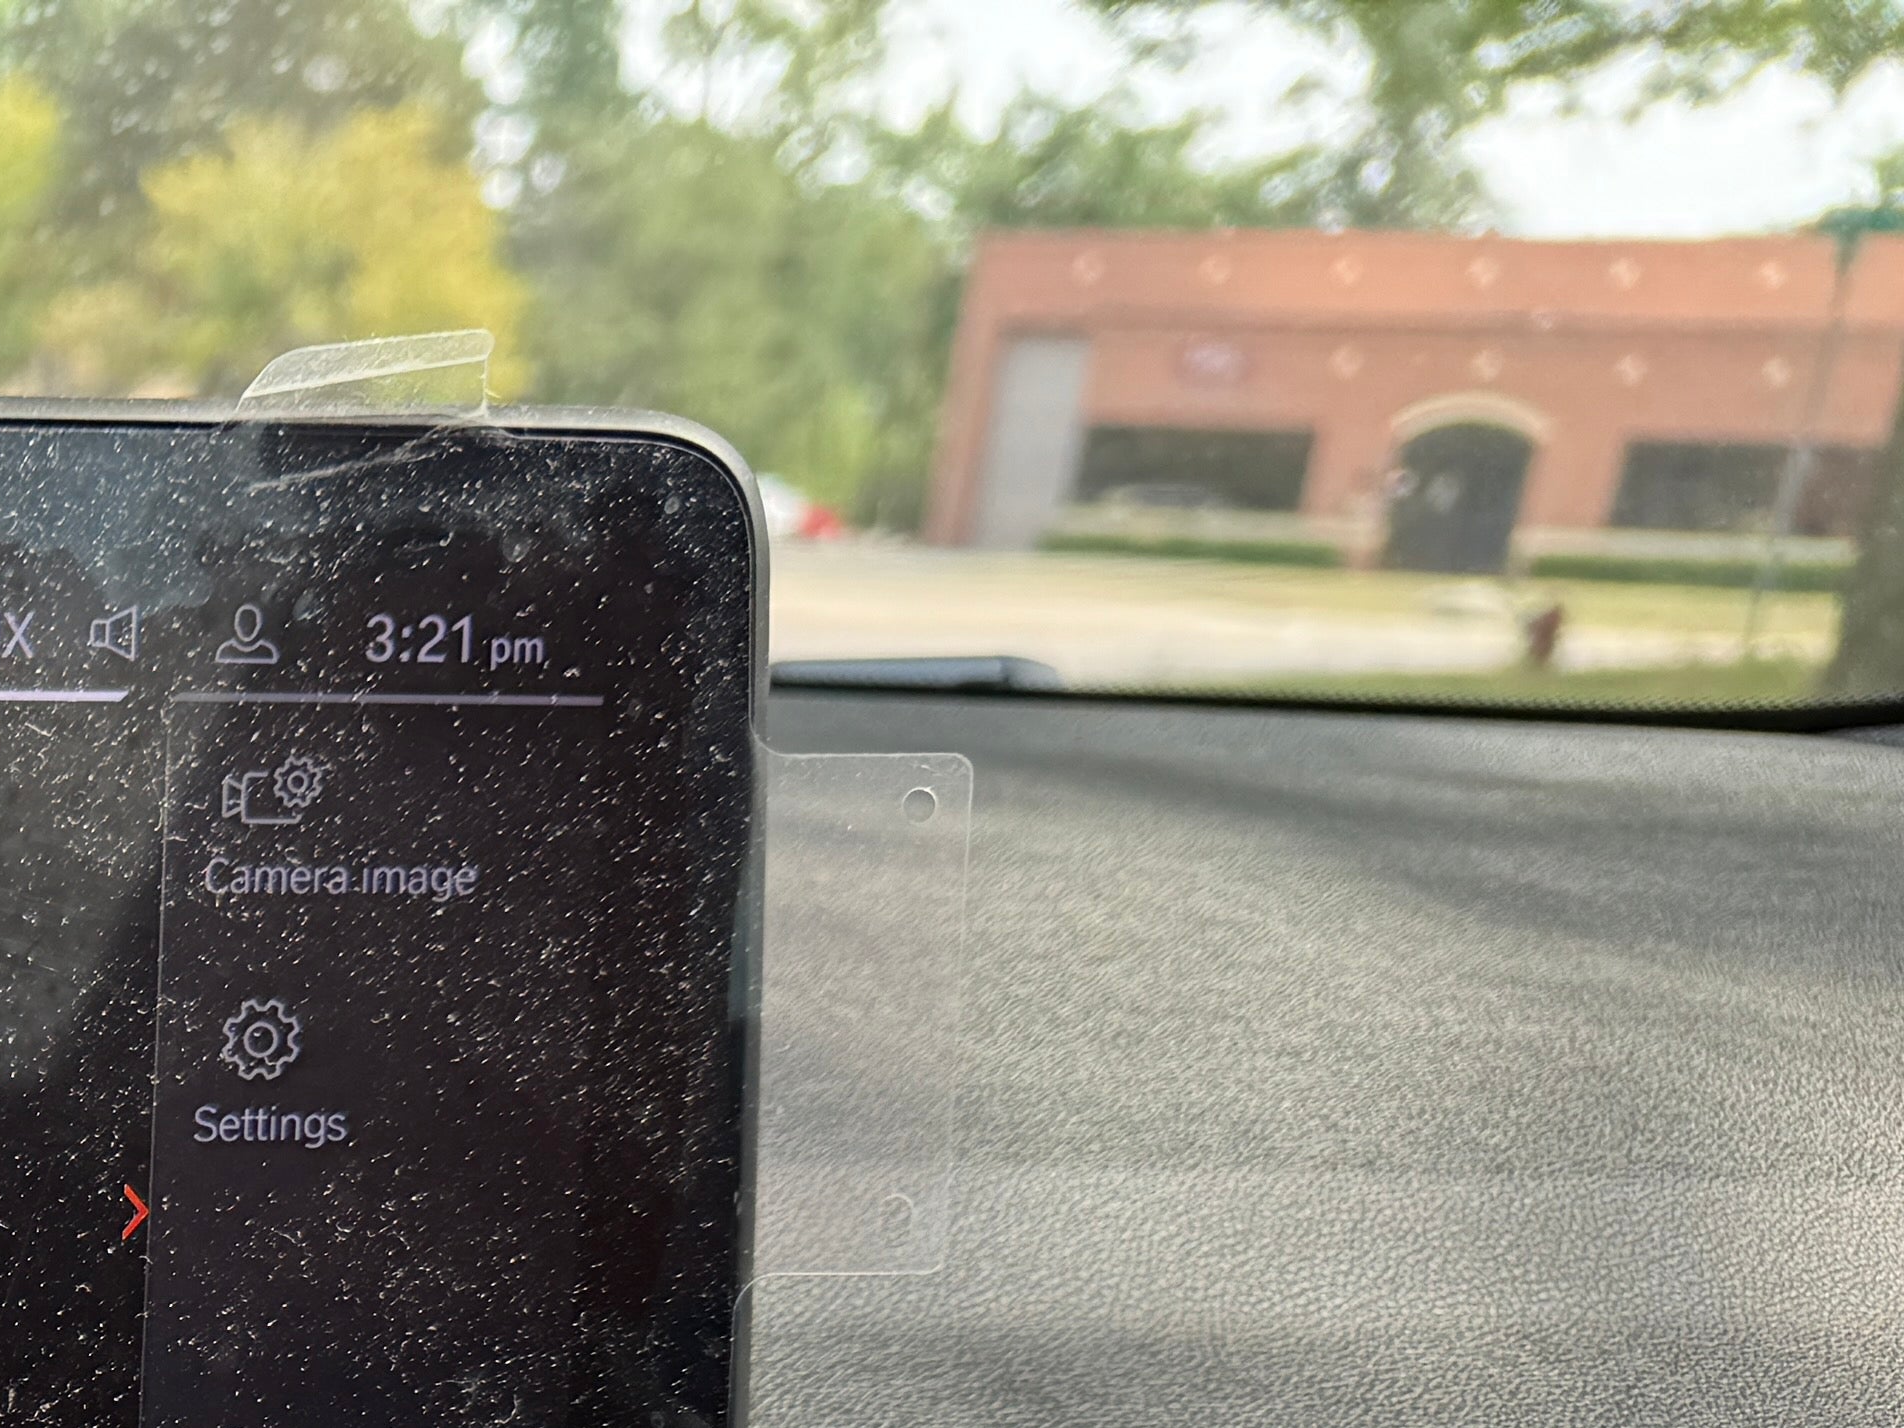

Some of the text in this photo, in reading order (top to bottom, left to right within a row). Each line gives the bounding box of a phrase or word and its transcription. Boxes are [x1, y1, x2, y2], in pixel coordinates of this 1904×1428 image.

[365, 614, 544, 672] 3:21 pm
[203, 857, 477, 902] Camera image
[193, 1105, 348, 1148] Settings
